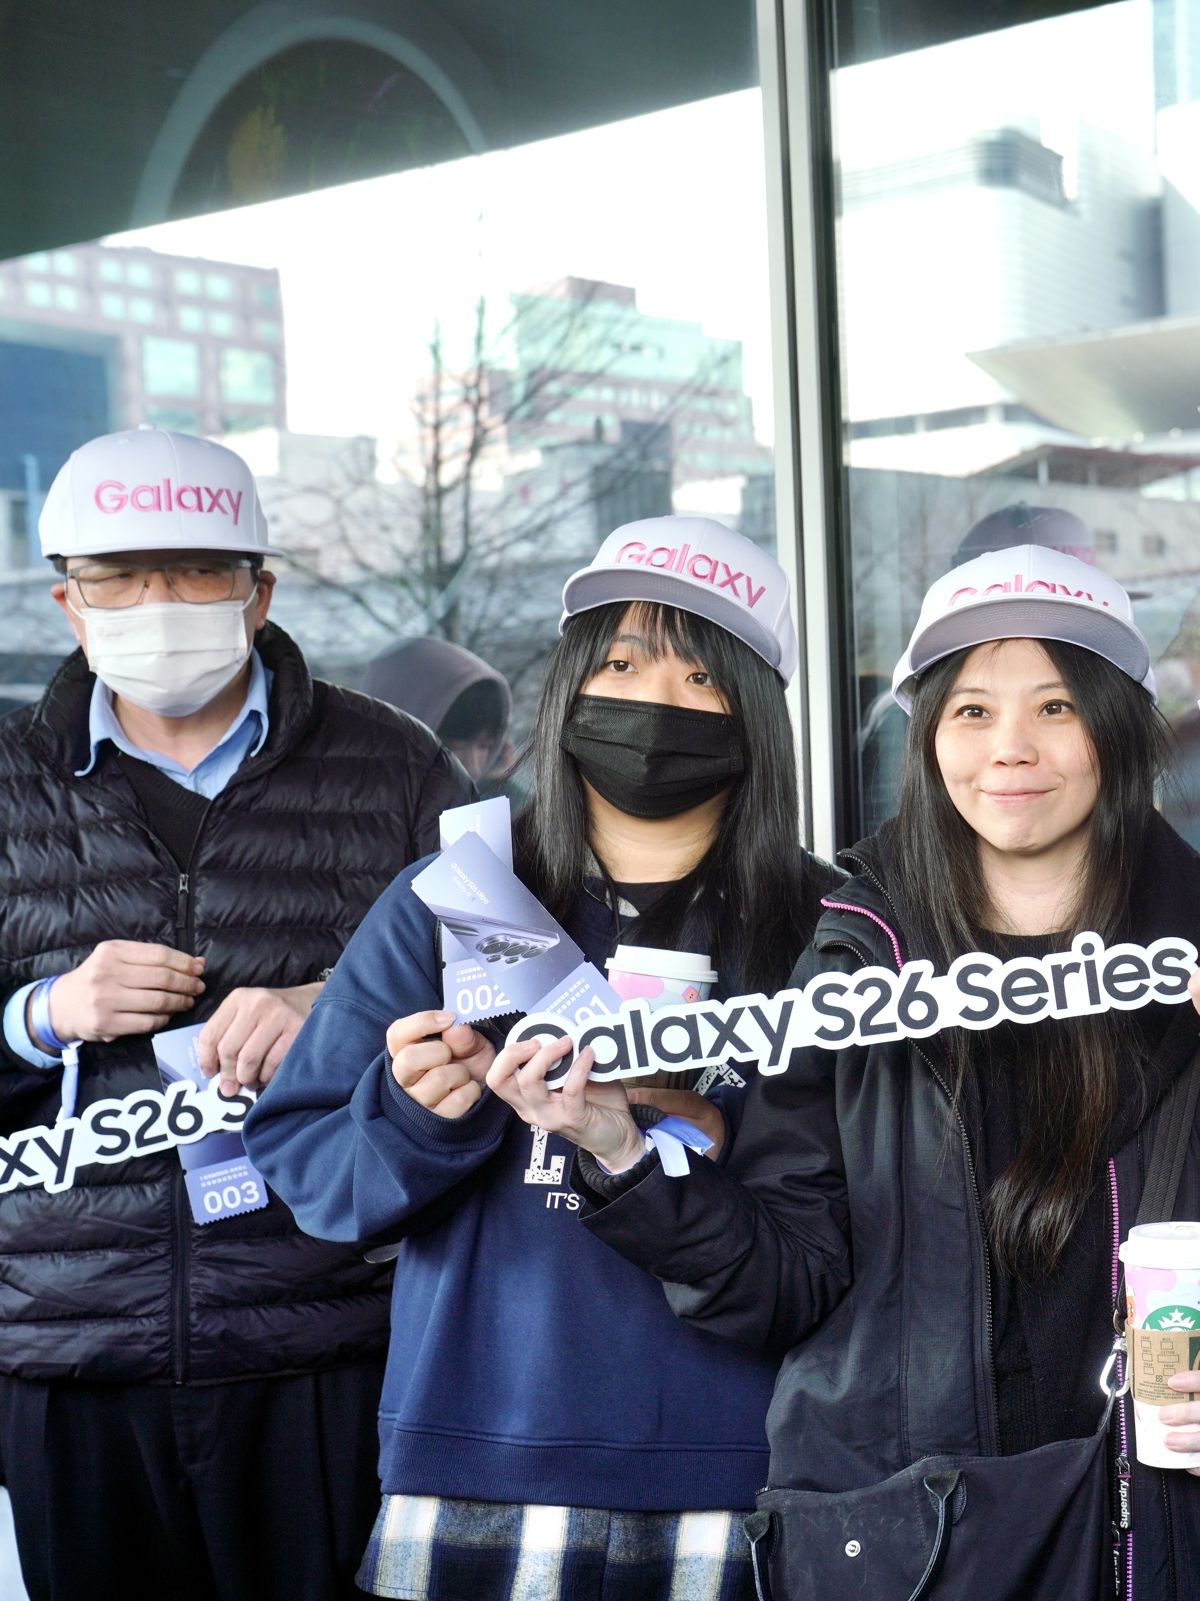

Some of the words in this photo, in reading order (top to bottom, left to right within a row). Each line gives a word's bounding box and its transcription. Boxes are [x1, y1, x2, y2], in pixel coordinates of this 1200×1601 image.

[94, 478, 243, 526] Galaxy
[811, 971, 940, 1042] S26
[955, 941, 1191, 1022] Series
[90, 1089, 204, 1157] S26
[203, 1180, 260, 1215] 003
[546, 1191, 580, 1210] IT'S
[1119, 1479, 1130, 1529] Superdry
